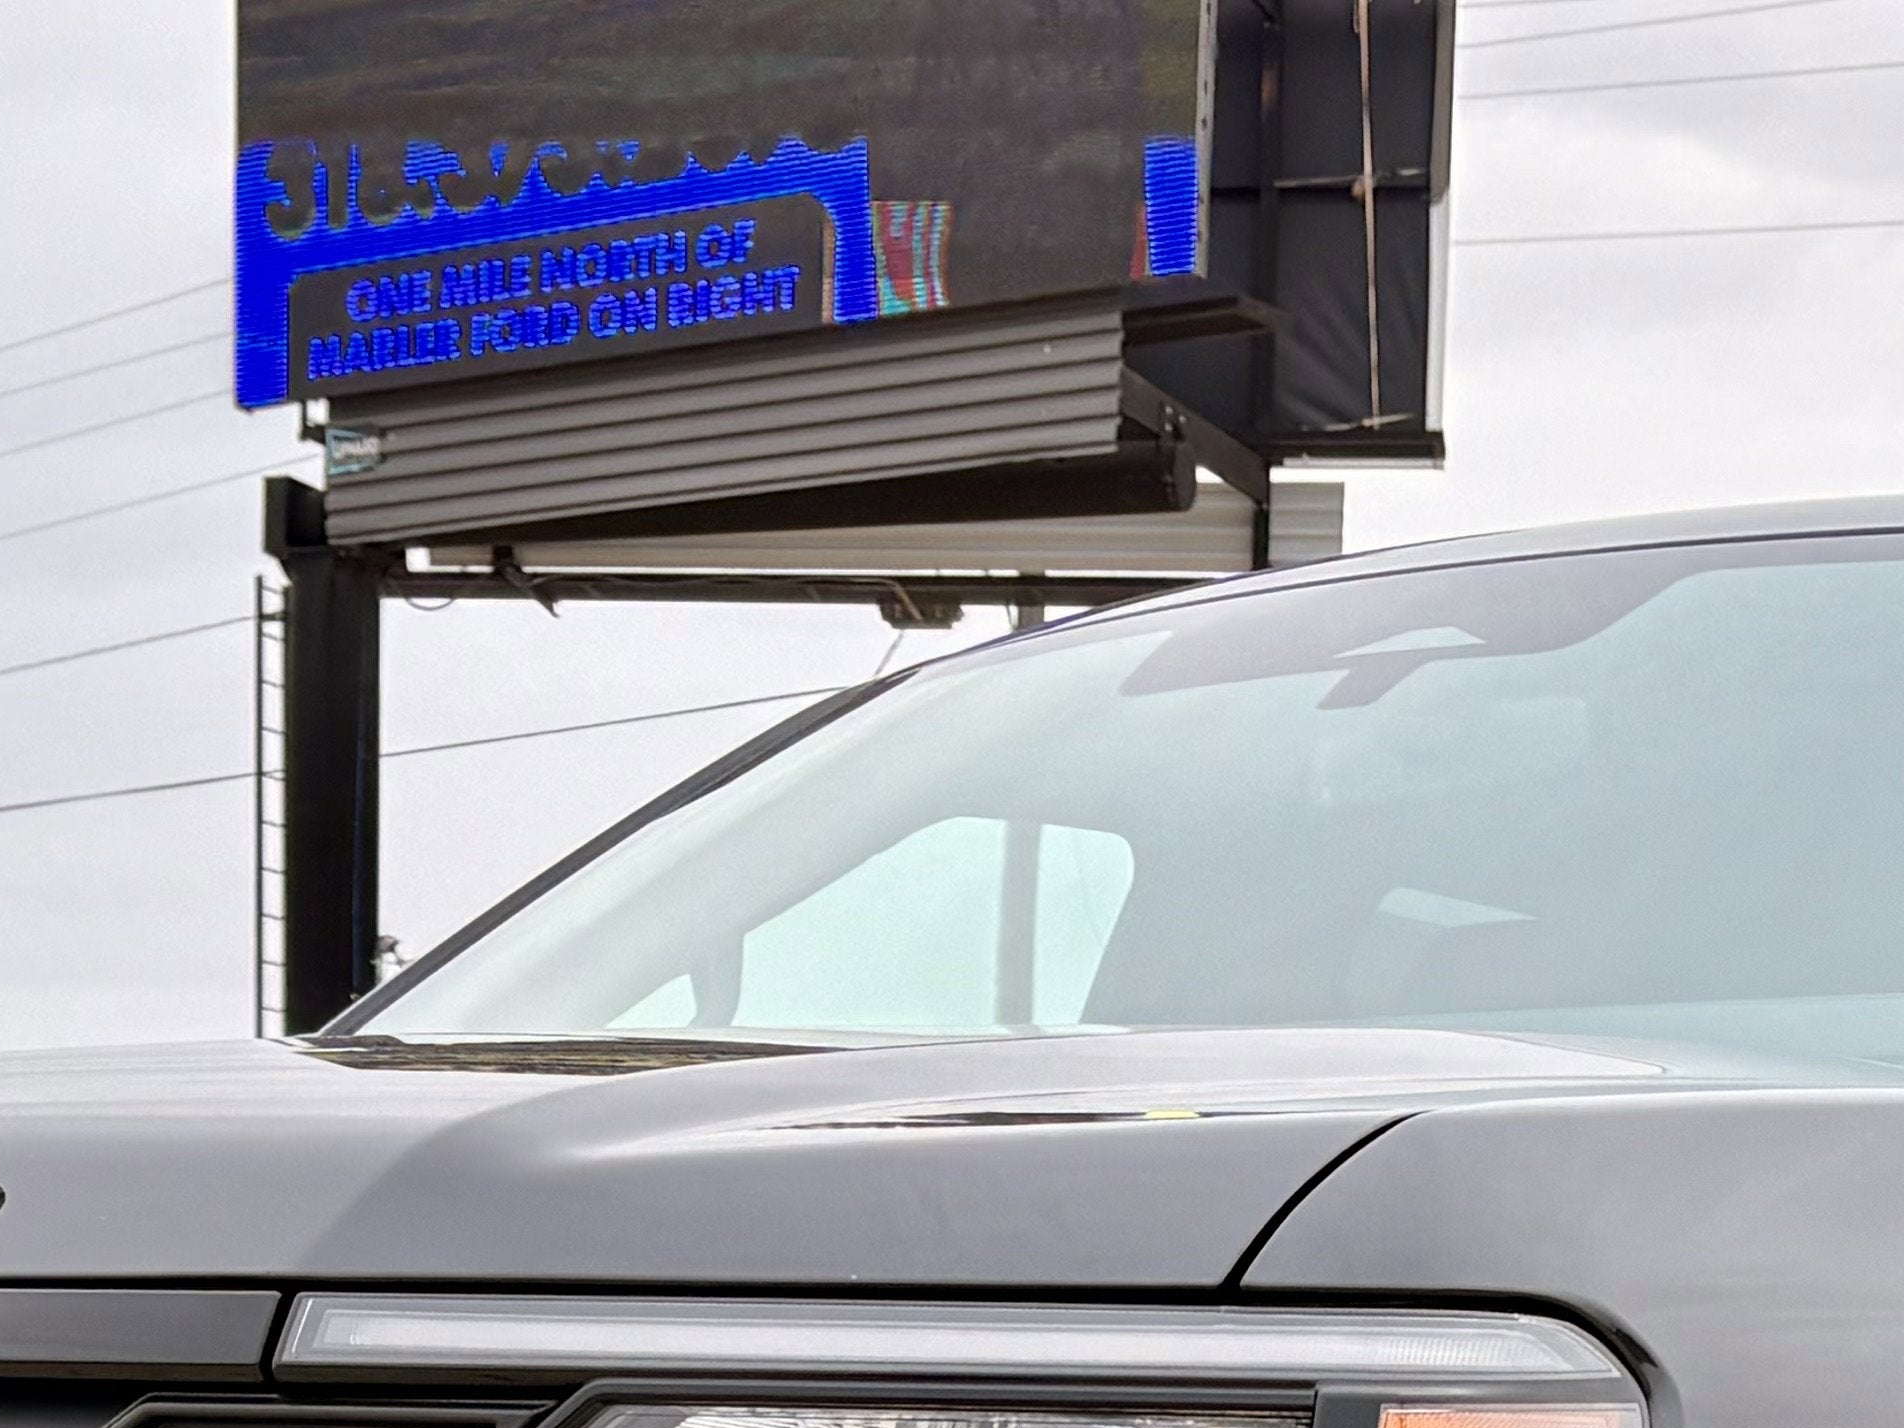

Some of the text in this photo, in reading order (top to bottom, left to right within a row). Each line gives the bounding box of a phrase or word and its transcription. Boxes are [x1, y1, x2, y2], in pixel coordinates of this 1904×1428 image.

[346, 217, 757, 323] ONE MILE NORTH OF
[469, 300, 581, 357] FORD
[588, 286, 658, 339] ON
[666, 264, 801, 327] RIGHT
